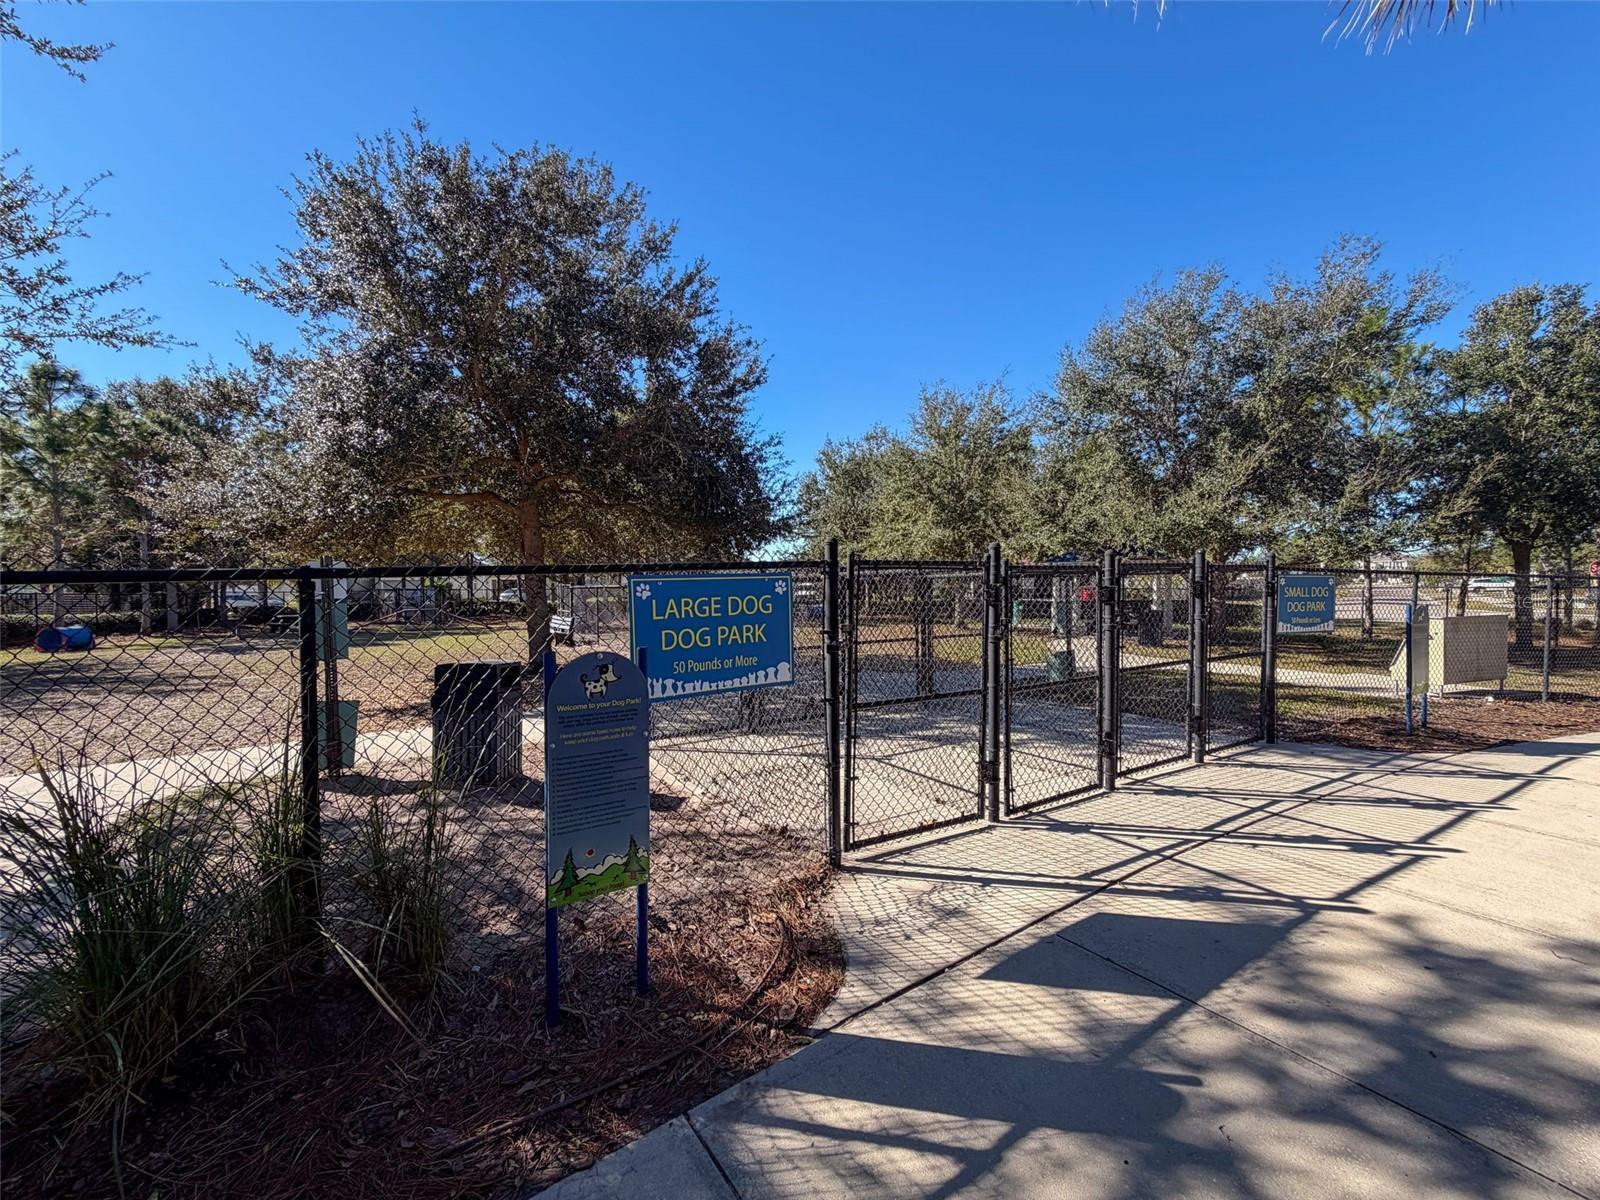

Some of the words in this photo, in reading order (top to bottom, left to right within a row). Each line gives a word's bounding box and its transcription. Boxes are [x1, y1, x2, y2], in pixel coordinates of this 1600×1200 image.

[1284, 587, 1310, 597] SMALL
[1311, 587, 1329, 597] DOG
[652, 597, 722, 620] LARGE
[727, 595, 773, 616] DOG
[1287, 602, 1306, 612] DOG
[1306, 601, 1326, 611] PARK
[661, 627, 711, 651] DOG
[717, 623, 767, 646] PARK
[673, 661, 686, 674] 50
[687, 657, 722, 673] Pounds
[725, 659, 734, 669] or
[735, 655, 758, 668] More
[557, 703, 588, 712] Welcome
[612, 699, 625, 707] Dog
[626, 697, 641, 705] Park!
